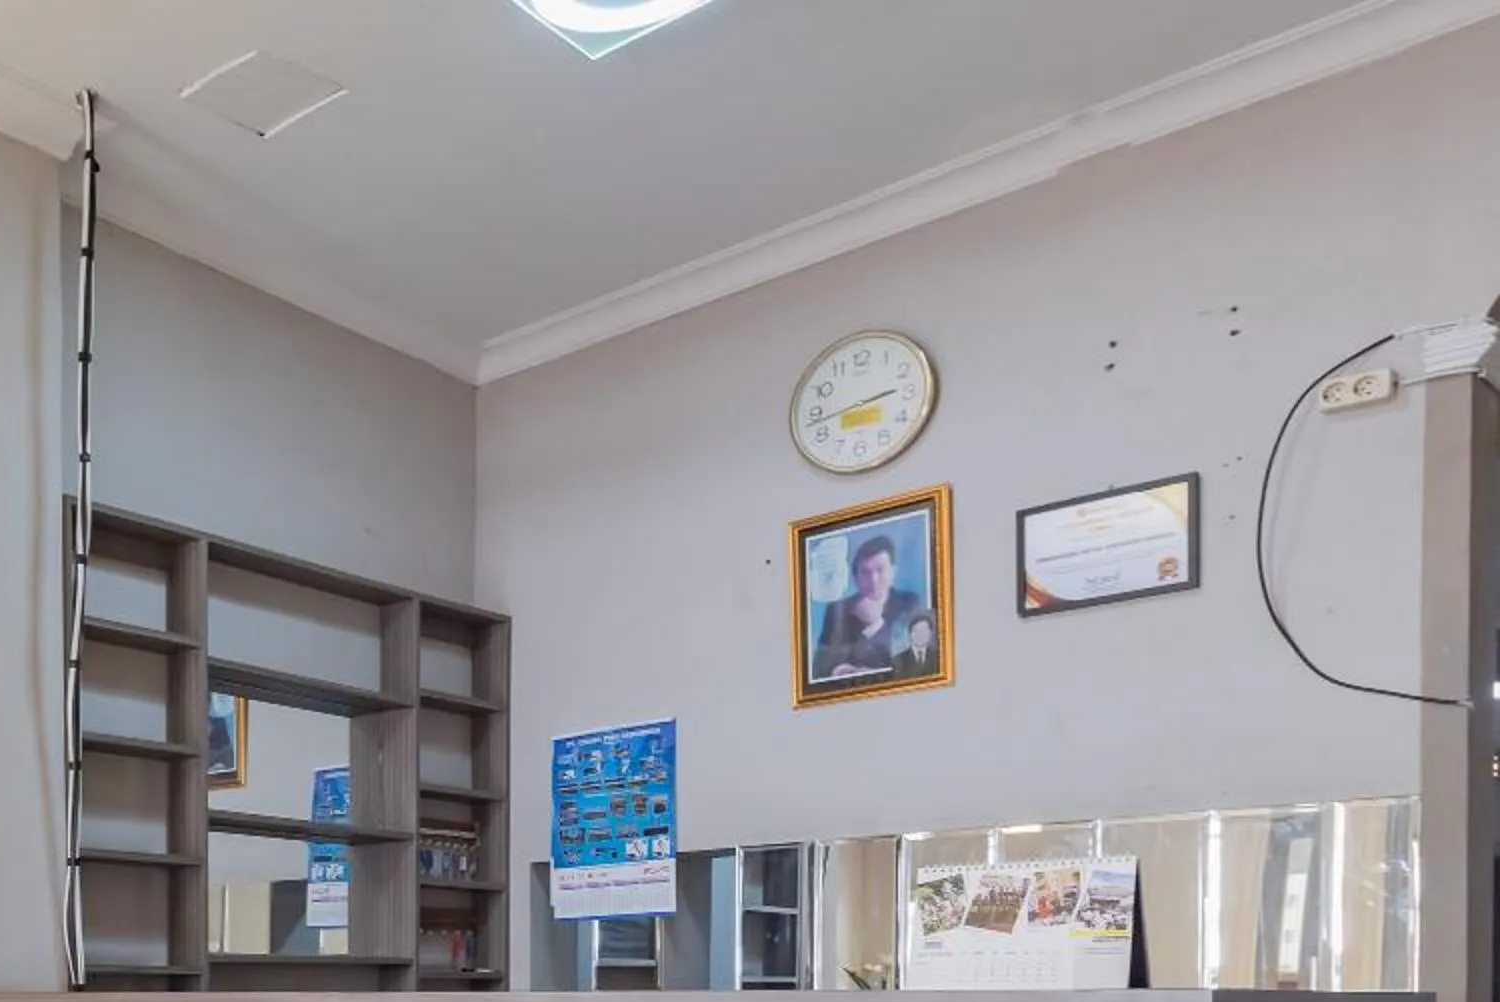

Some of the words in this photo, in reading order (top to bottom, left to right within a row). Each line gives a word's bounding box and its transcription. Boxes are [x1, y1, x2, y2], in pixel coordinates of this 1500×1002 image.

[852, 349, 871, 367] 12
[832, 359, 845, 377] 11
[895, 362, 910, 379] 2
[903, 383, 916, 401] 3
